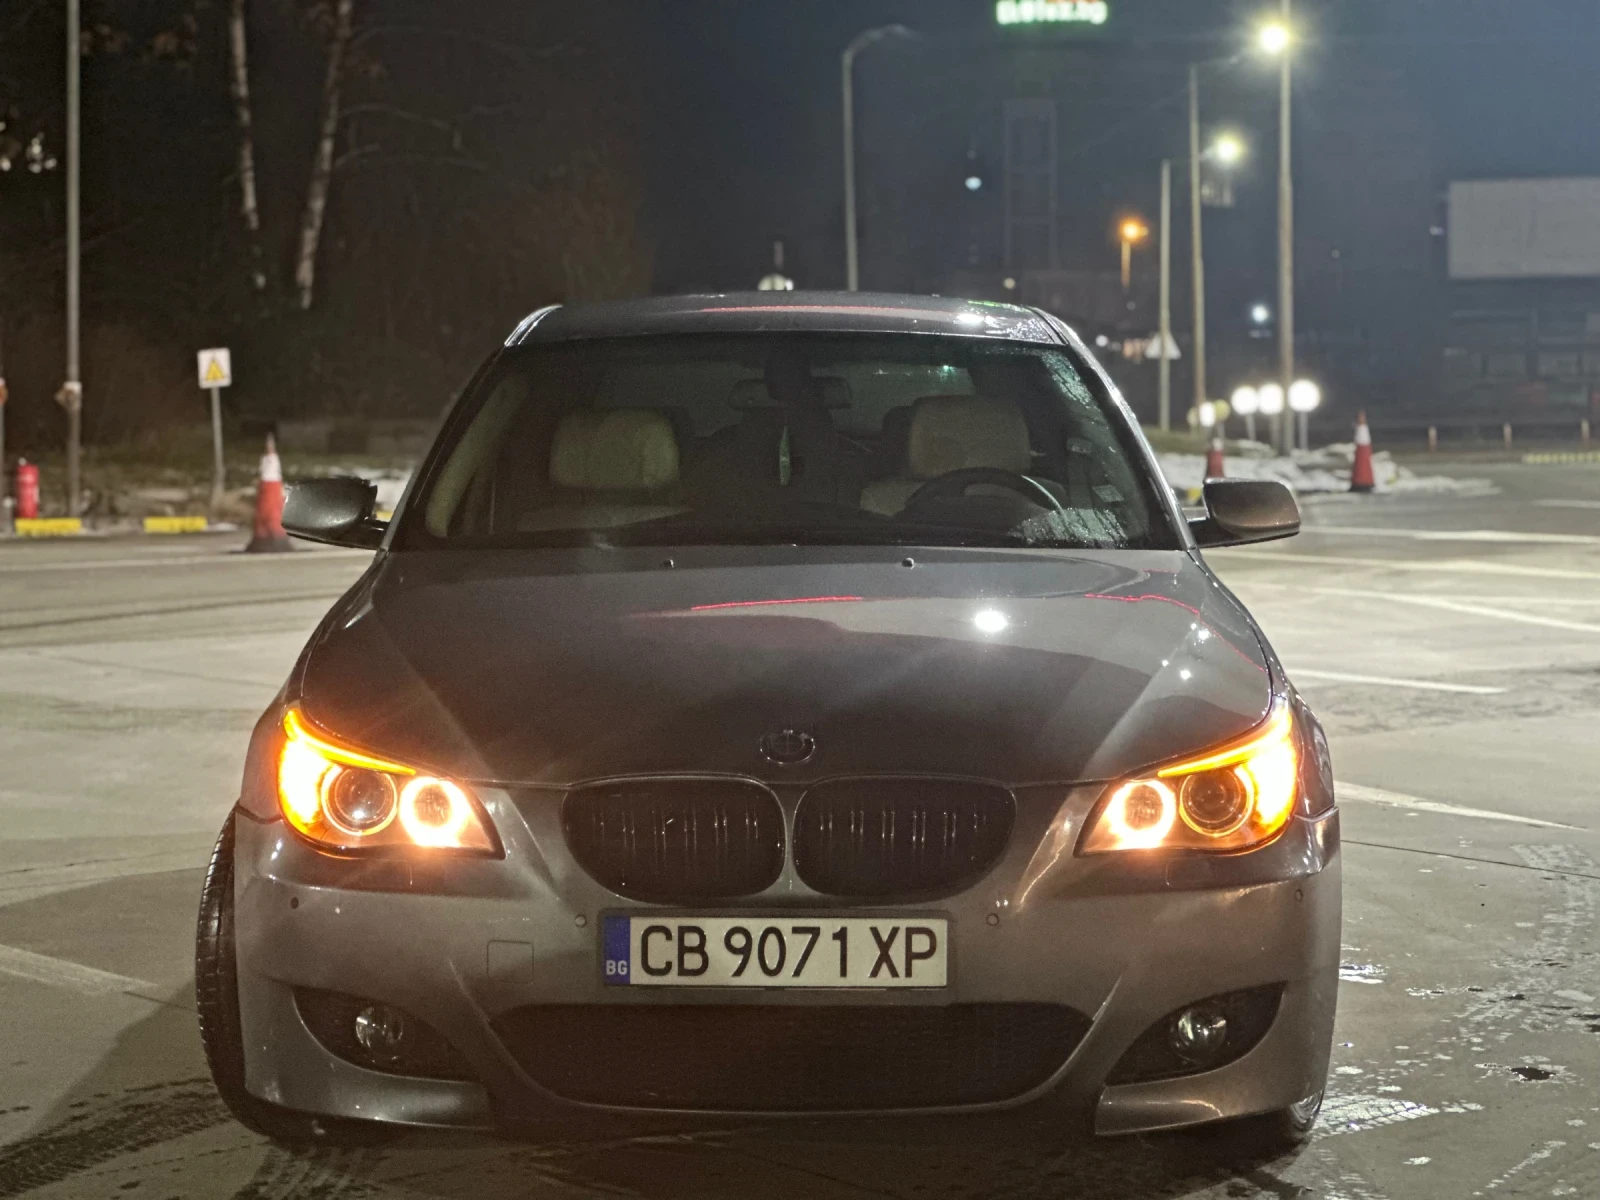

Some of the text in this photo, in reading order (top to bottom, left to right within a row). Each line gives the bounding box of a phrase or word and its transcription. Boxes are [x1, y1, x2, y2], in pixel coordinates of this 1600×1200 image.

[605, 959, 628, 976] BG
[641, 925, 937, 979] CB 9071 XP
